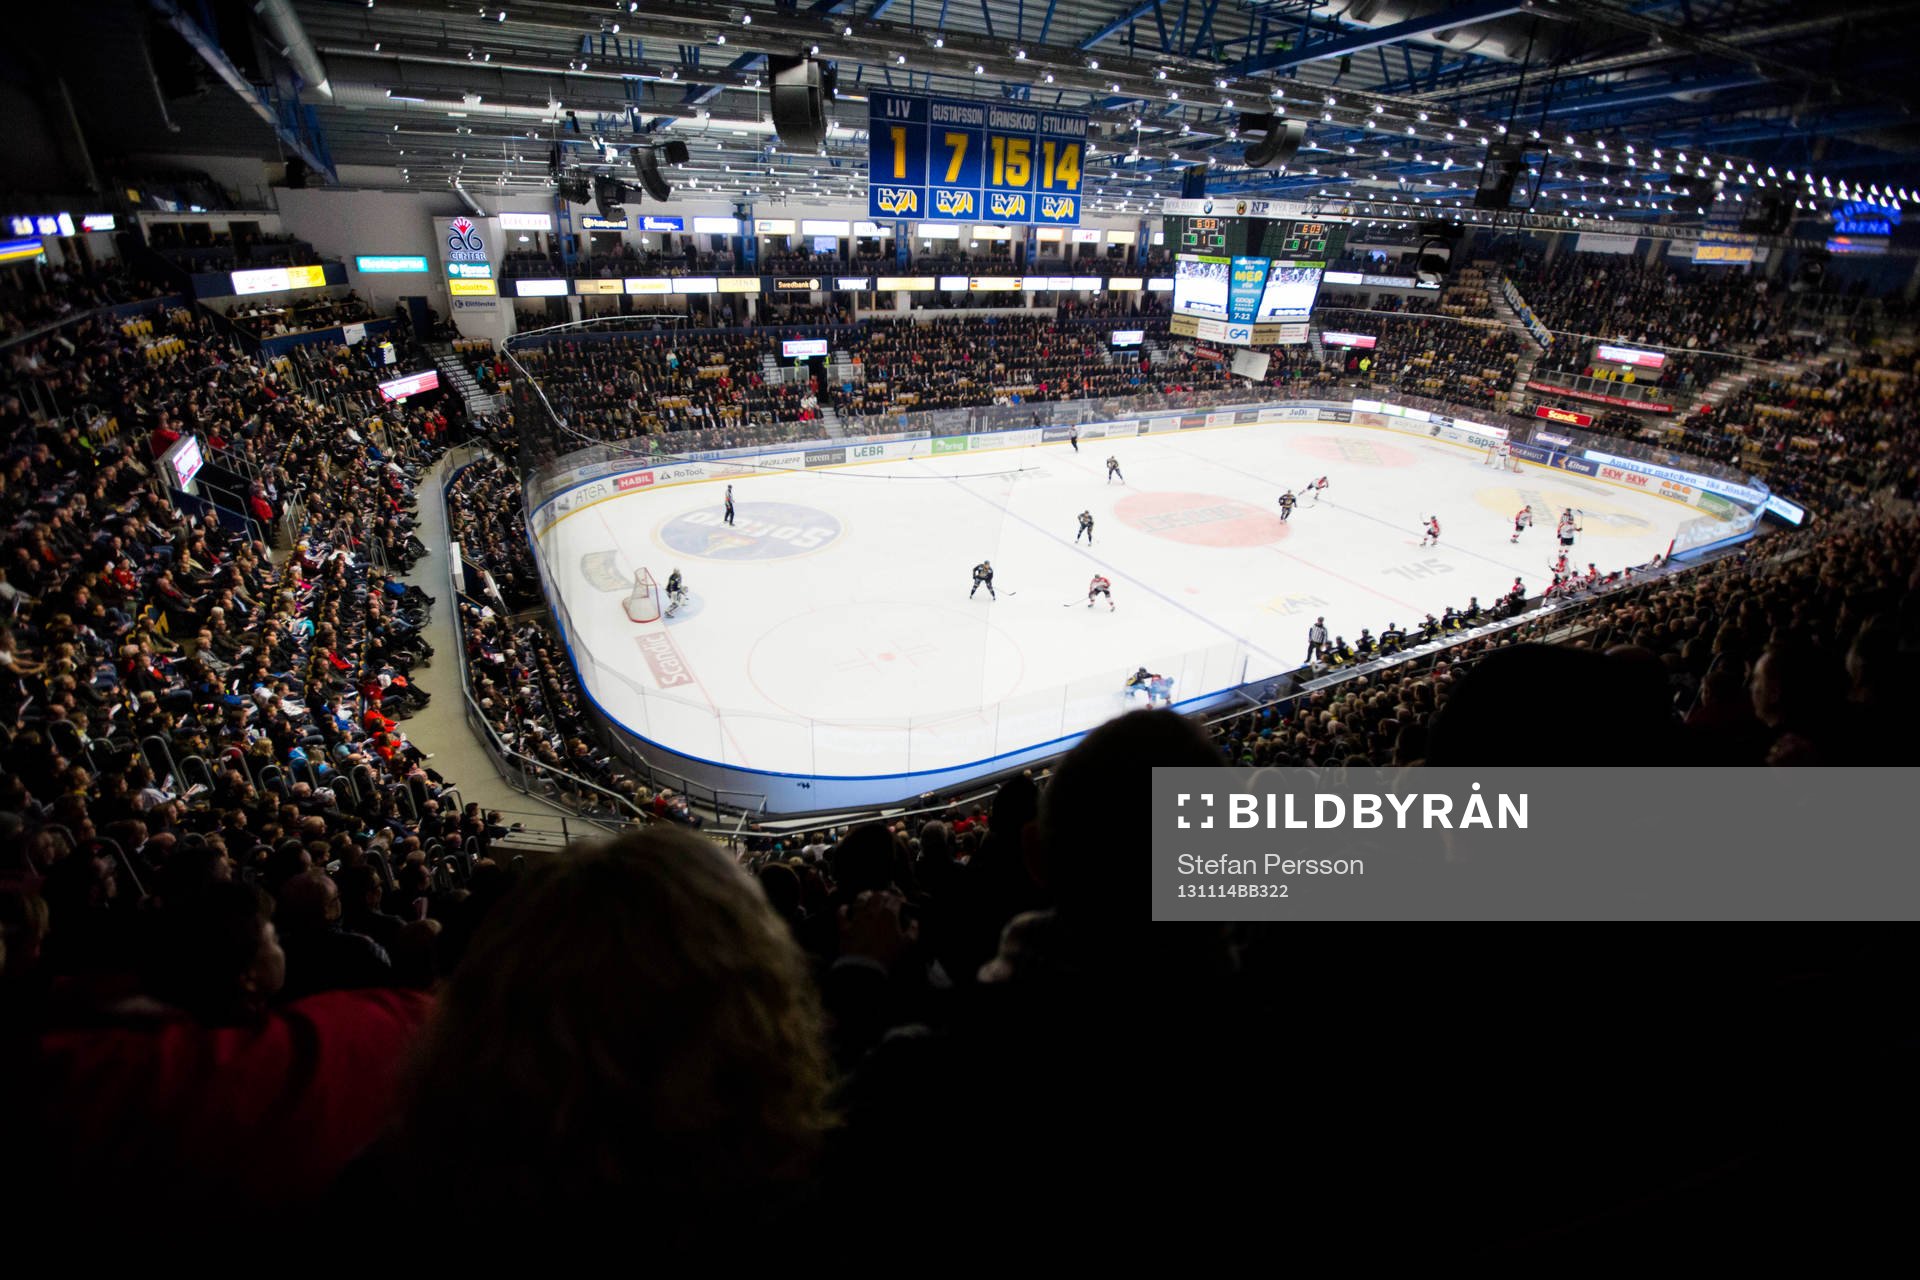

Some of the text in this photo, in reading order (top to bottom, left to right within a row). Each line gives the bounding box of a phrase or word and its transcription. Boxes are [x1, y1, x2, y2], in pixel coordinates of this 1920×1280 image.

[887, 99, 911, 118] LIV
[932, 104, 983, 125] GUSTAFSSON
[989, 106, 1036, 130] ÖRNSKOG
[1043, 117, 1086, 135] STILLMAN
[891, 126, 906, 178] 1
[945, 132, 968, 182] 7
[991, 136, 1031, 187] 15
[1043, 141, 1080, 190] 14
[878, 187, 917, 215] HV71
[936, 189, 973, 216] HV71
[991, 193, 1025, 218] HV71
[1042, 196, 1074, 220] HV71
[1251, 202, 1269, 213] NP
[450, 251, 486, 261] CENTER
[778, 279, 809, 289] Swedbank
[1547, 410, 1578, 423] Scandic
[1468, 434, 1496, 449] sapa
[620, 476, 651, 488] HABIL
[1601, 467, 1649, 487] SEW SEW
[1609, 458, 1640, 472] Analys
[1655, 469, 1696, 484] matchen
[1381, 559, 1454, 581] SHL
[643, 634, 691, 687] Scandic
